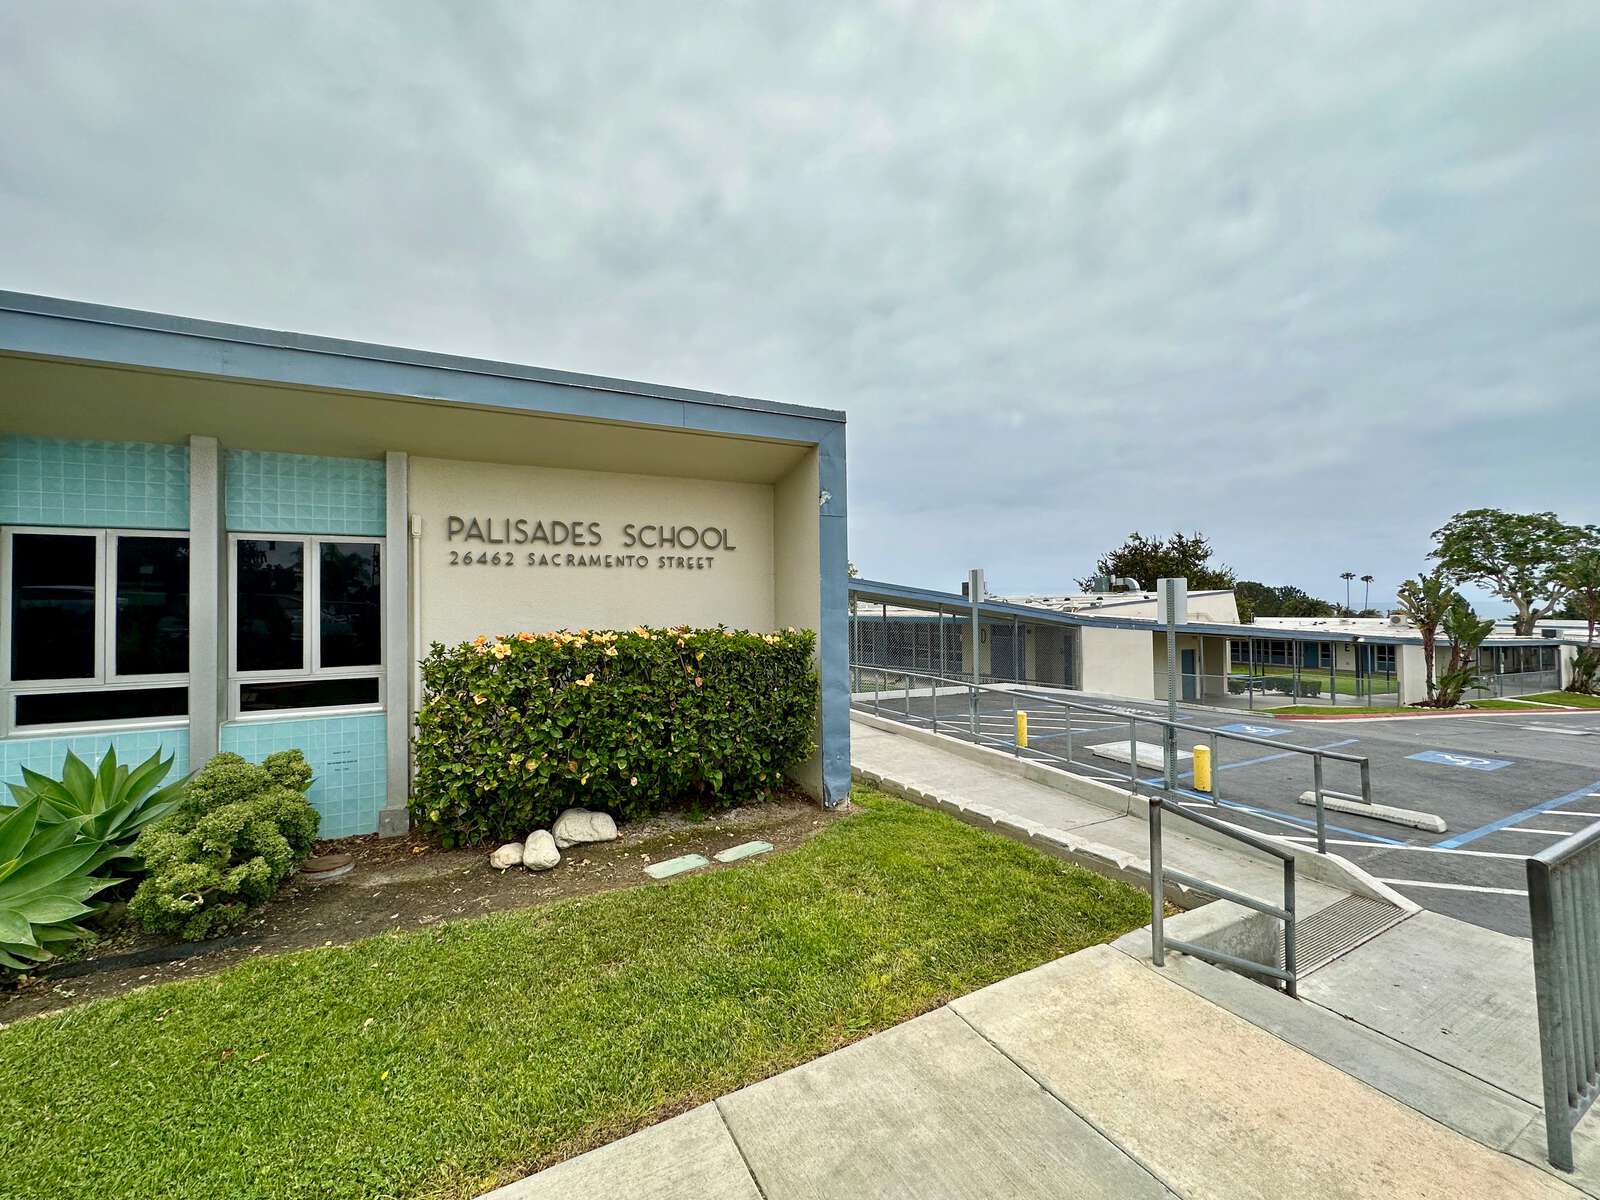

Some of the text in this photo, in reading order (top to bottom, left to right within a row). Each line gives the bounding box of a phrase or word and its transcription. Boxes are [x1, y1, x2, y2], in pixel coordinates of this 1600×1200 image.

[447, 515, 737, 551] PALISADES SCHOOL
[449, 550, 714, 570] 26462 SACRAMENTO STREET
